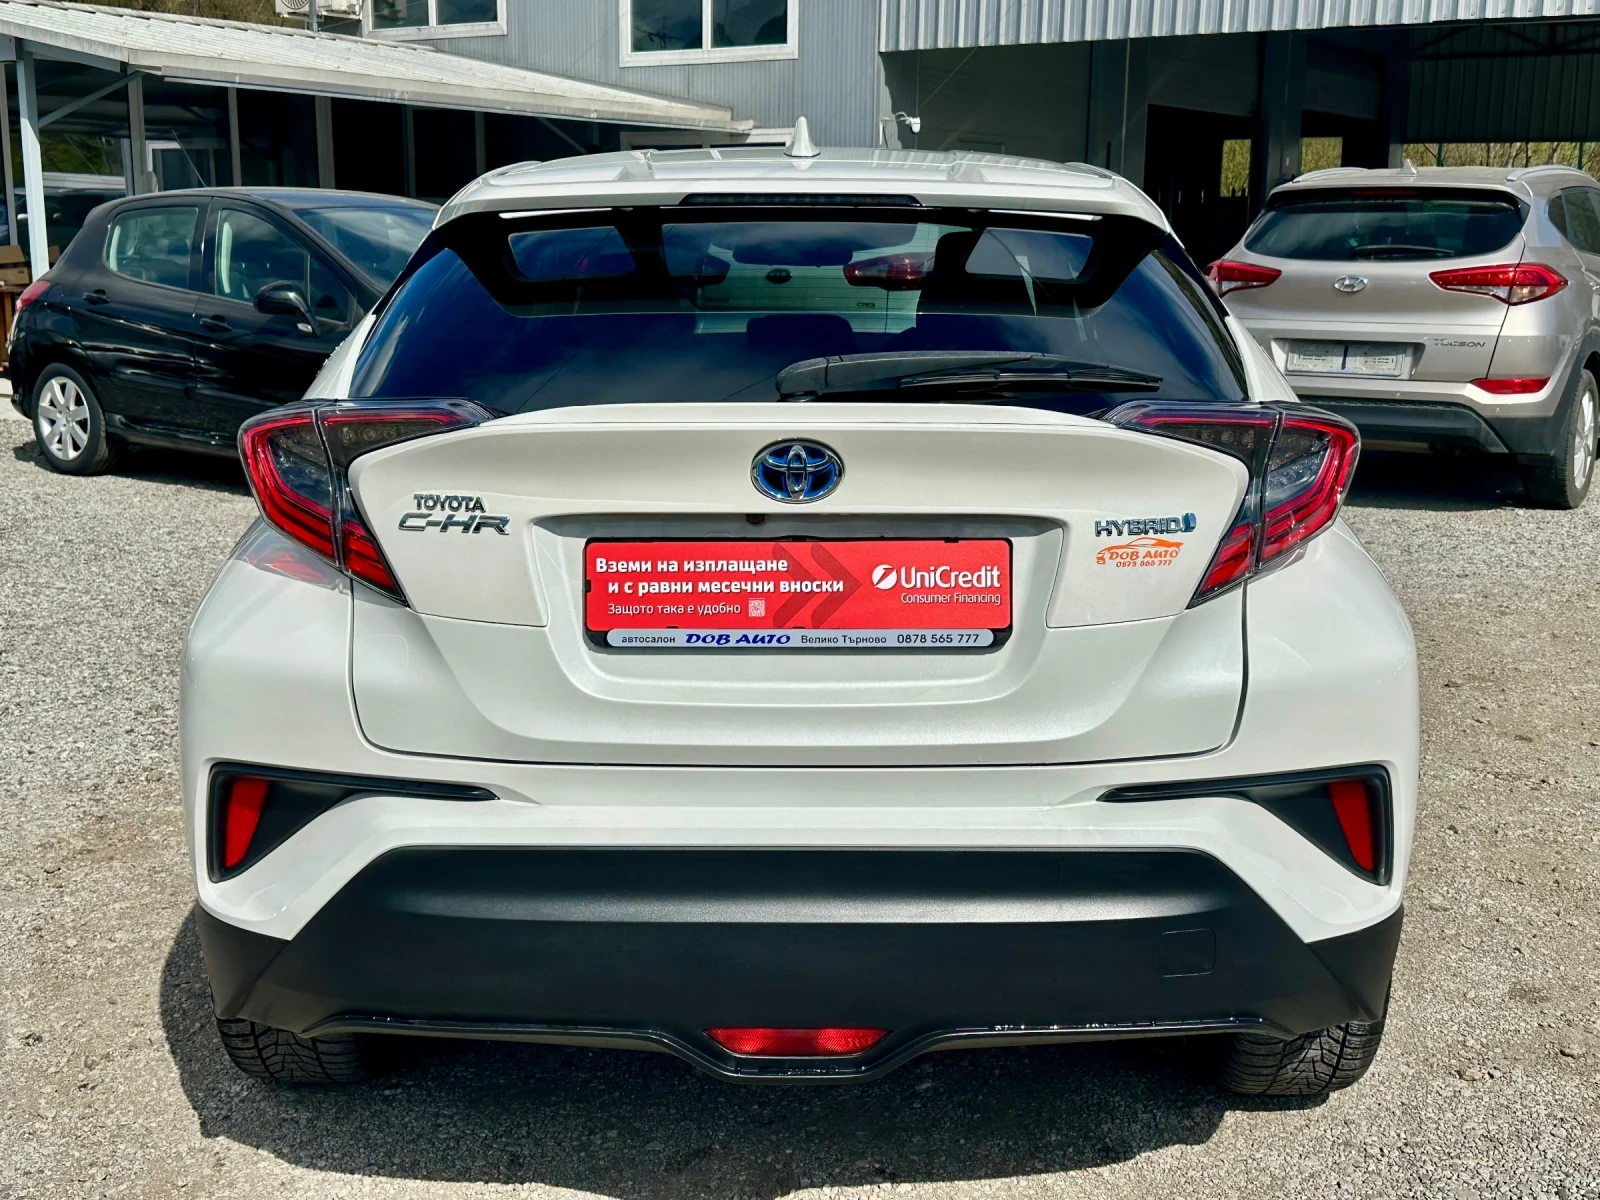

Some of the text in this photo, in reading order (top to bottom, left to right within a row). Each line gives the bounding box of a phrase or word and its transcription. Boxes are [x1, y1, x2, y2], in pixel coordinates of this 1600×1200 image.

[1434, 338, 1486, 348] TUCSON
[413, 493, 486, 513] TOYOTA
[398, 512, 510, 535] C-HR
[1095, 517, 1181, 537] HYBRID
[1108, 549, 1179, 561] DOB AUTO
[595, 557, 788, 575] Вземи на изплащане
[900, 565, 1001, 588] UniCredit
[608, 580, 844, 597] и с равни месечни вноски
[900, 592, 1001, 606] Consumer Financing
[607, 601, 741, 616] Защото така е удобно
[621, 633, 980, 646] автосалон DOB AUTO Велико Търново 0878 565 777
